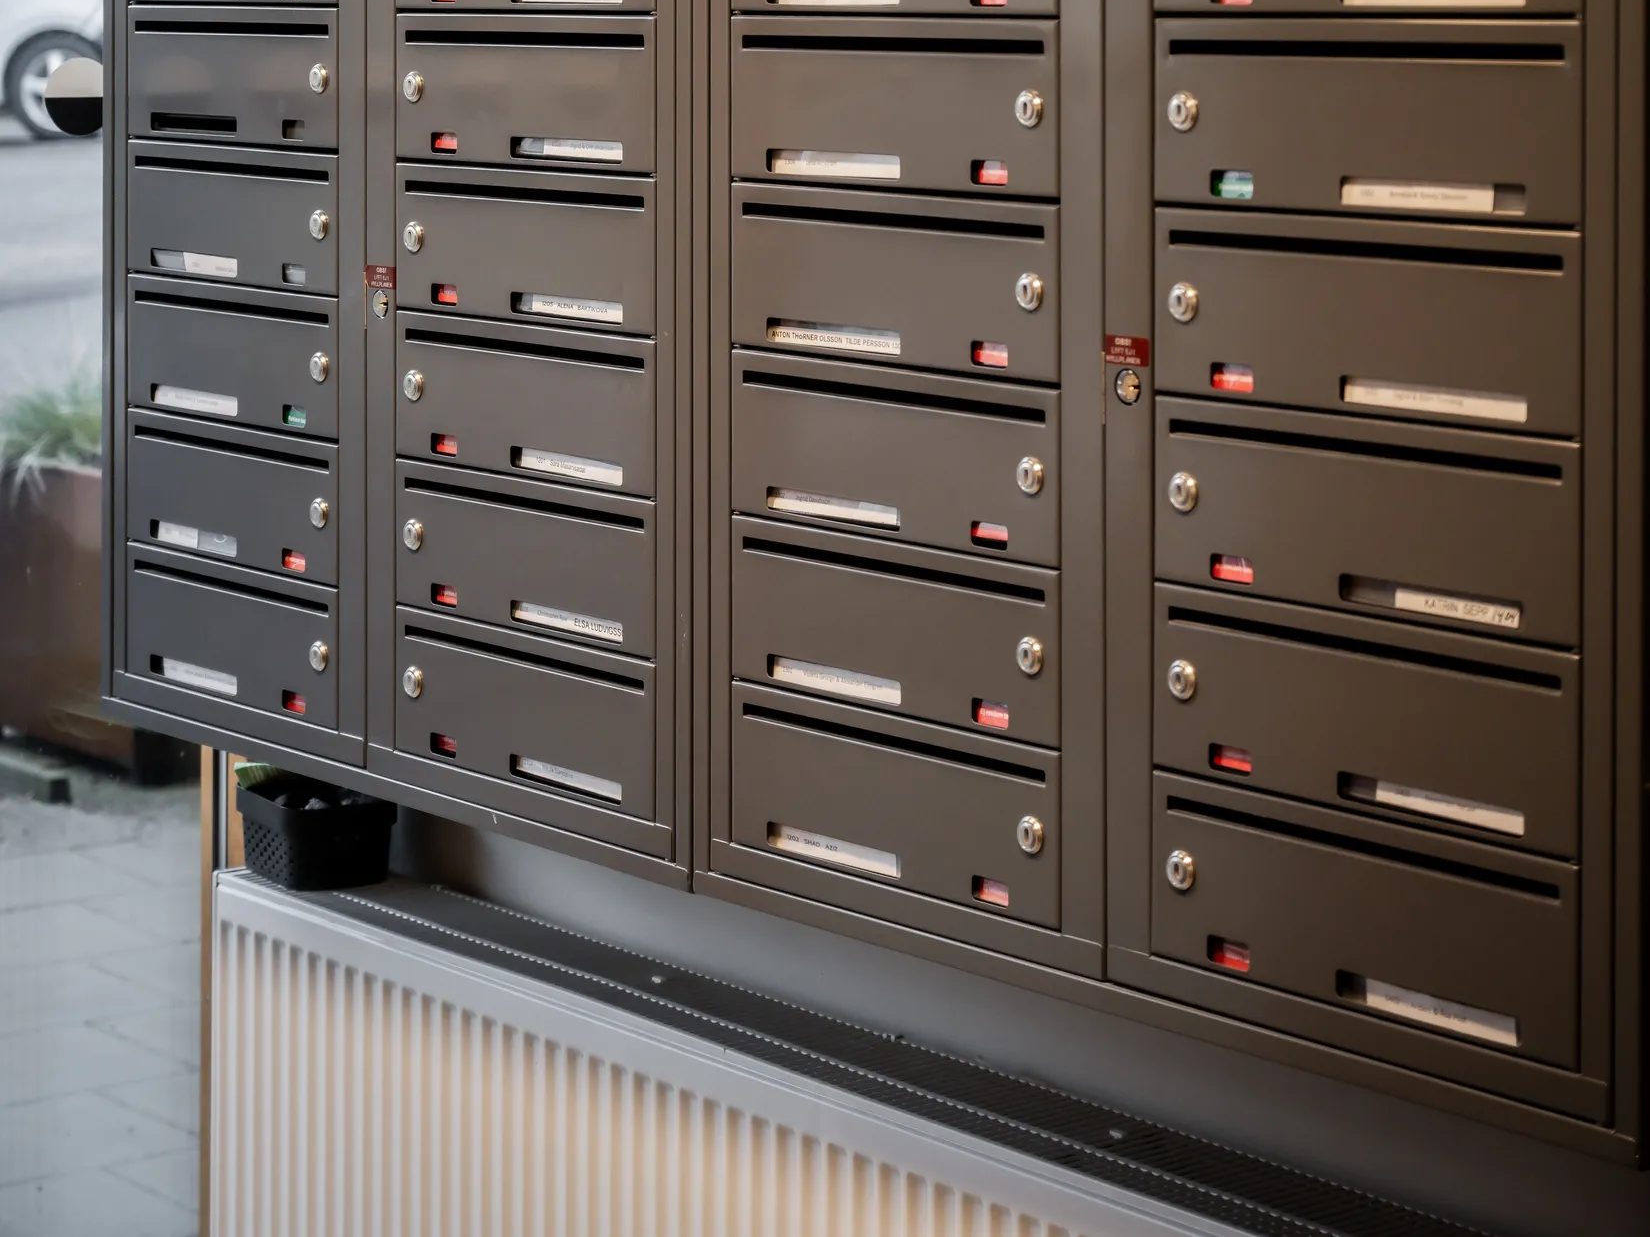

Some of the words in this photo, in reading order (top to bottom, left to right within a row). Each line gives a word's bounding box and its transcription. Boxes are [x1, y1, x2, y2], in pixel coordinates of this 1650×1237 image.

[557, 301, 574, 310] ALENA
[577, 304, 608, 314] BARTIKOVA
[771, 330, 791, 338] ANTON
[819, 335, 843, 344] OLSSON
[845, 337, 861, 346] TILDE
[862, 339, 890, 348] PERSSON
[1424, 597, 1459, 613] KATRIN
[1462, 602, 1489, 616] SEPP
[574, 617, 590, 630] ELSA
[590, 622, 623, 638] LUDVIGSS
[786, 833, 800, 843] 1202
[803, 838, 821, 848] SHAD
[824, 843, 838, 853] AZIZ
